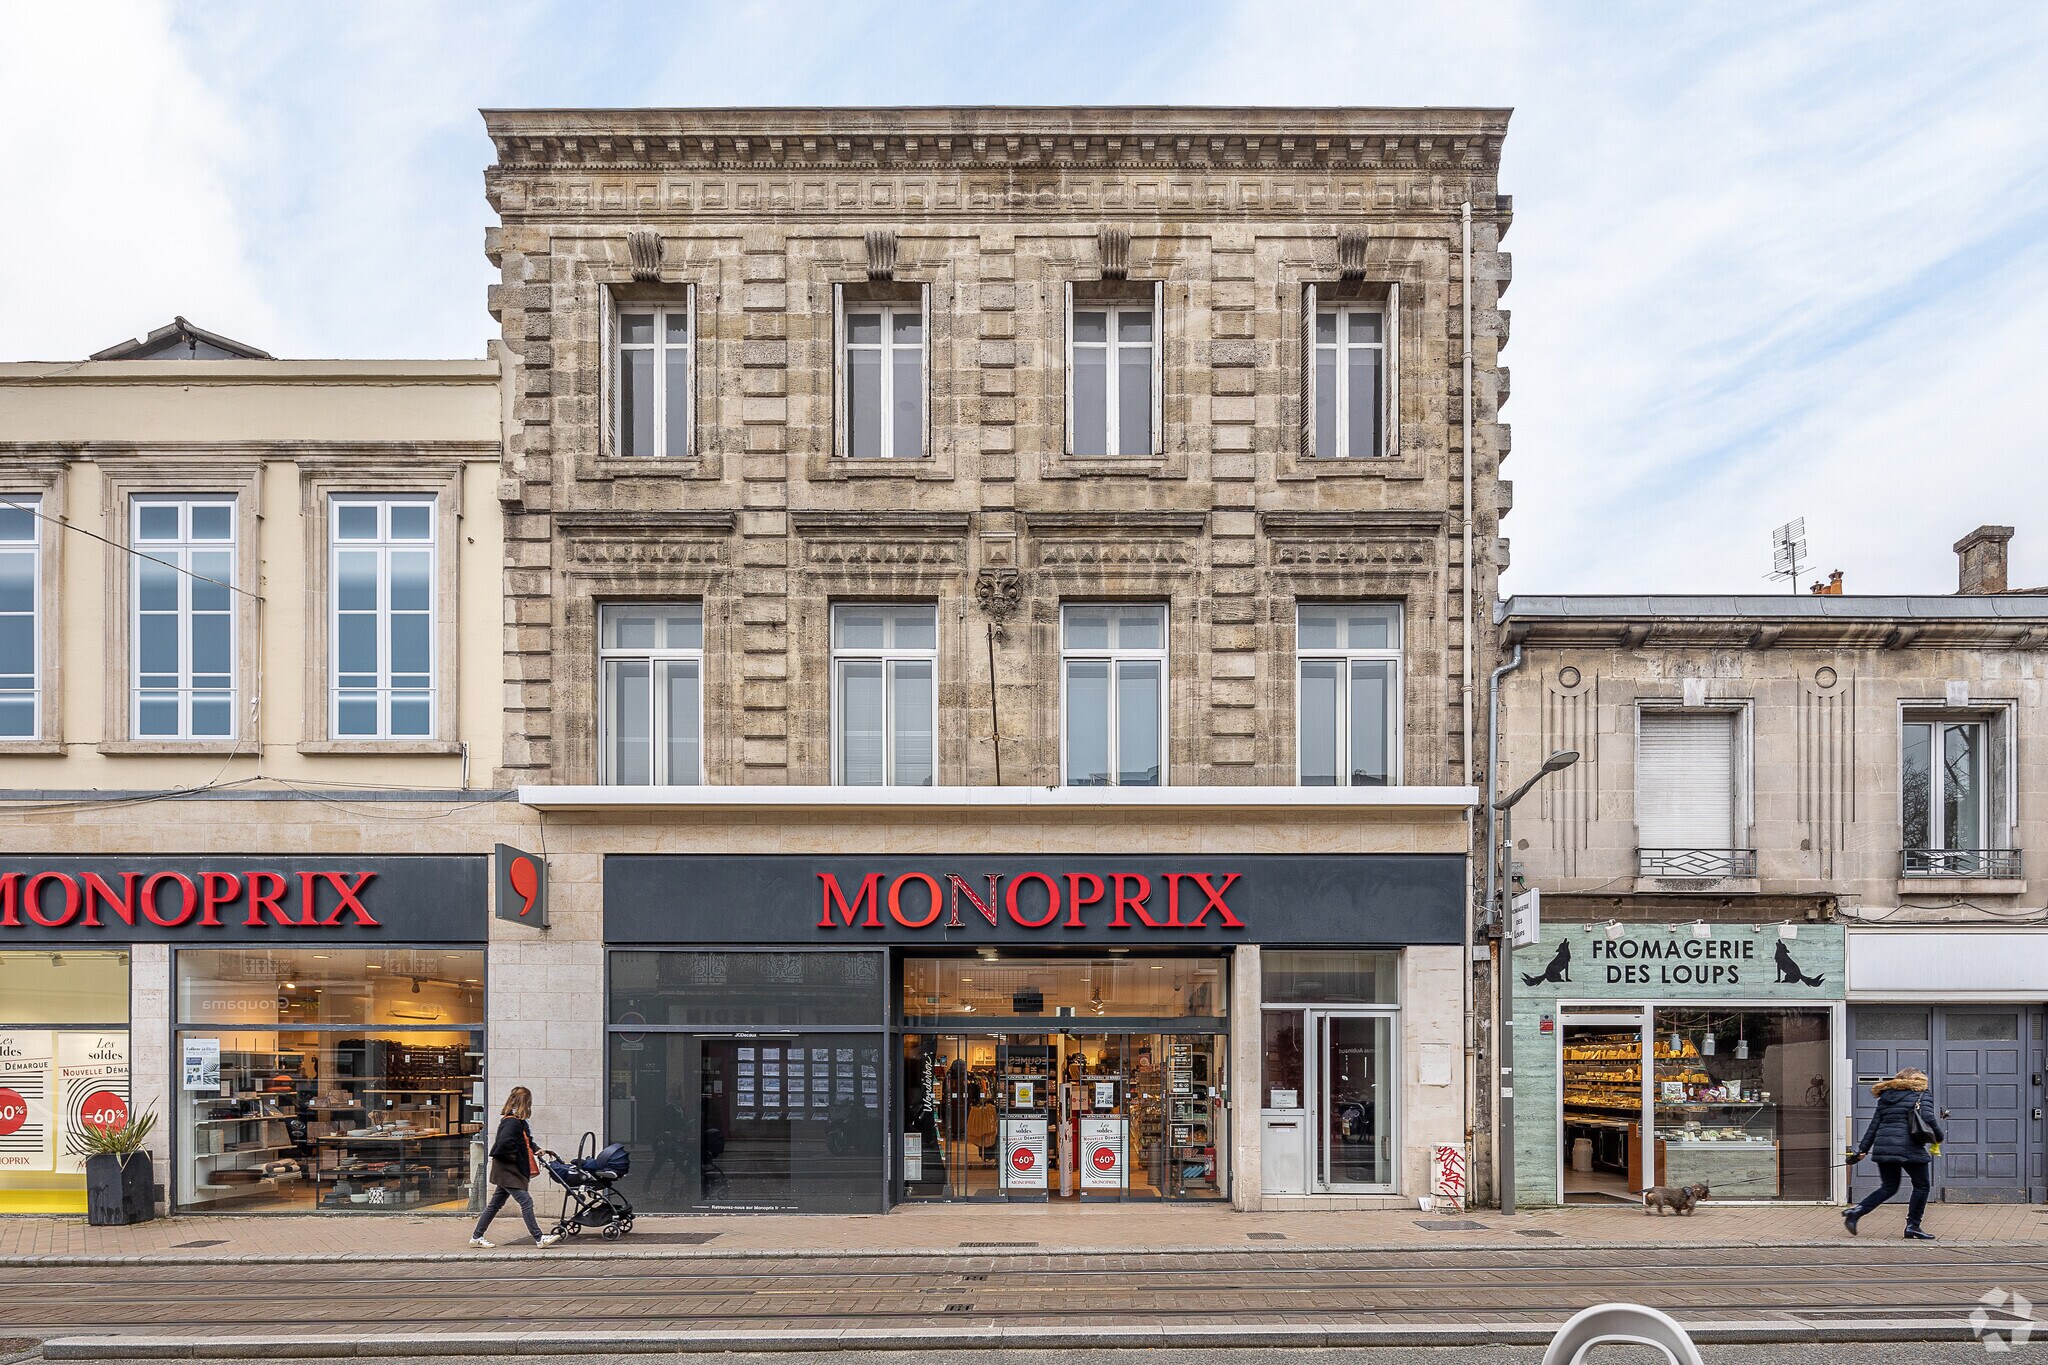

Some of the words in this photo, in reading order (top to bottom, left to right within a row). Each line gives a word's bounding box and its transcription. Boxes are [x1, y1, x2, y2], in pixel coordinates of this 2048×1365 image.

[815, 871, 1246, 928] MONOPRIX
[1592, 939, 1754, 959] FROMAGERIE
[1606, 965, 1650, 984] DES
[1661, 965, 1739, 984] LOUPS
[96, 1037, 116, 1049] Les
[88, 1049, 123, 1060] soldes
[5, 1061, 49, 1071] DÉMARQUE
[62, 1067, 103, 1077] NOUVELLE
[923, 1055, 933, 1112] Wonderbox
